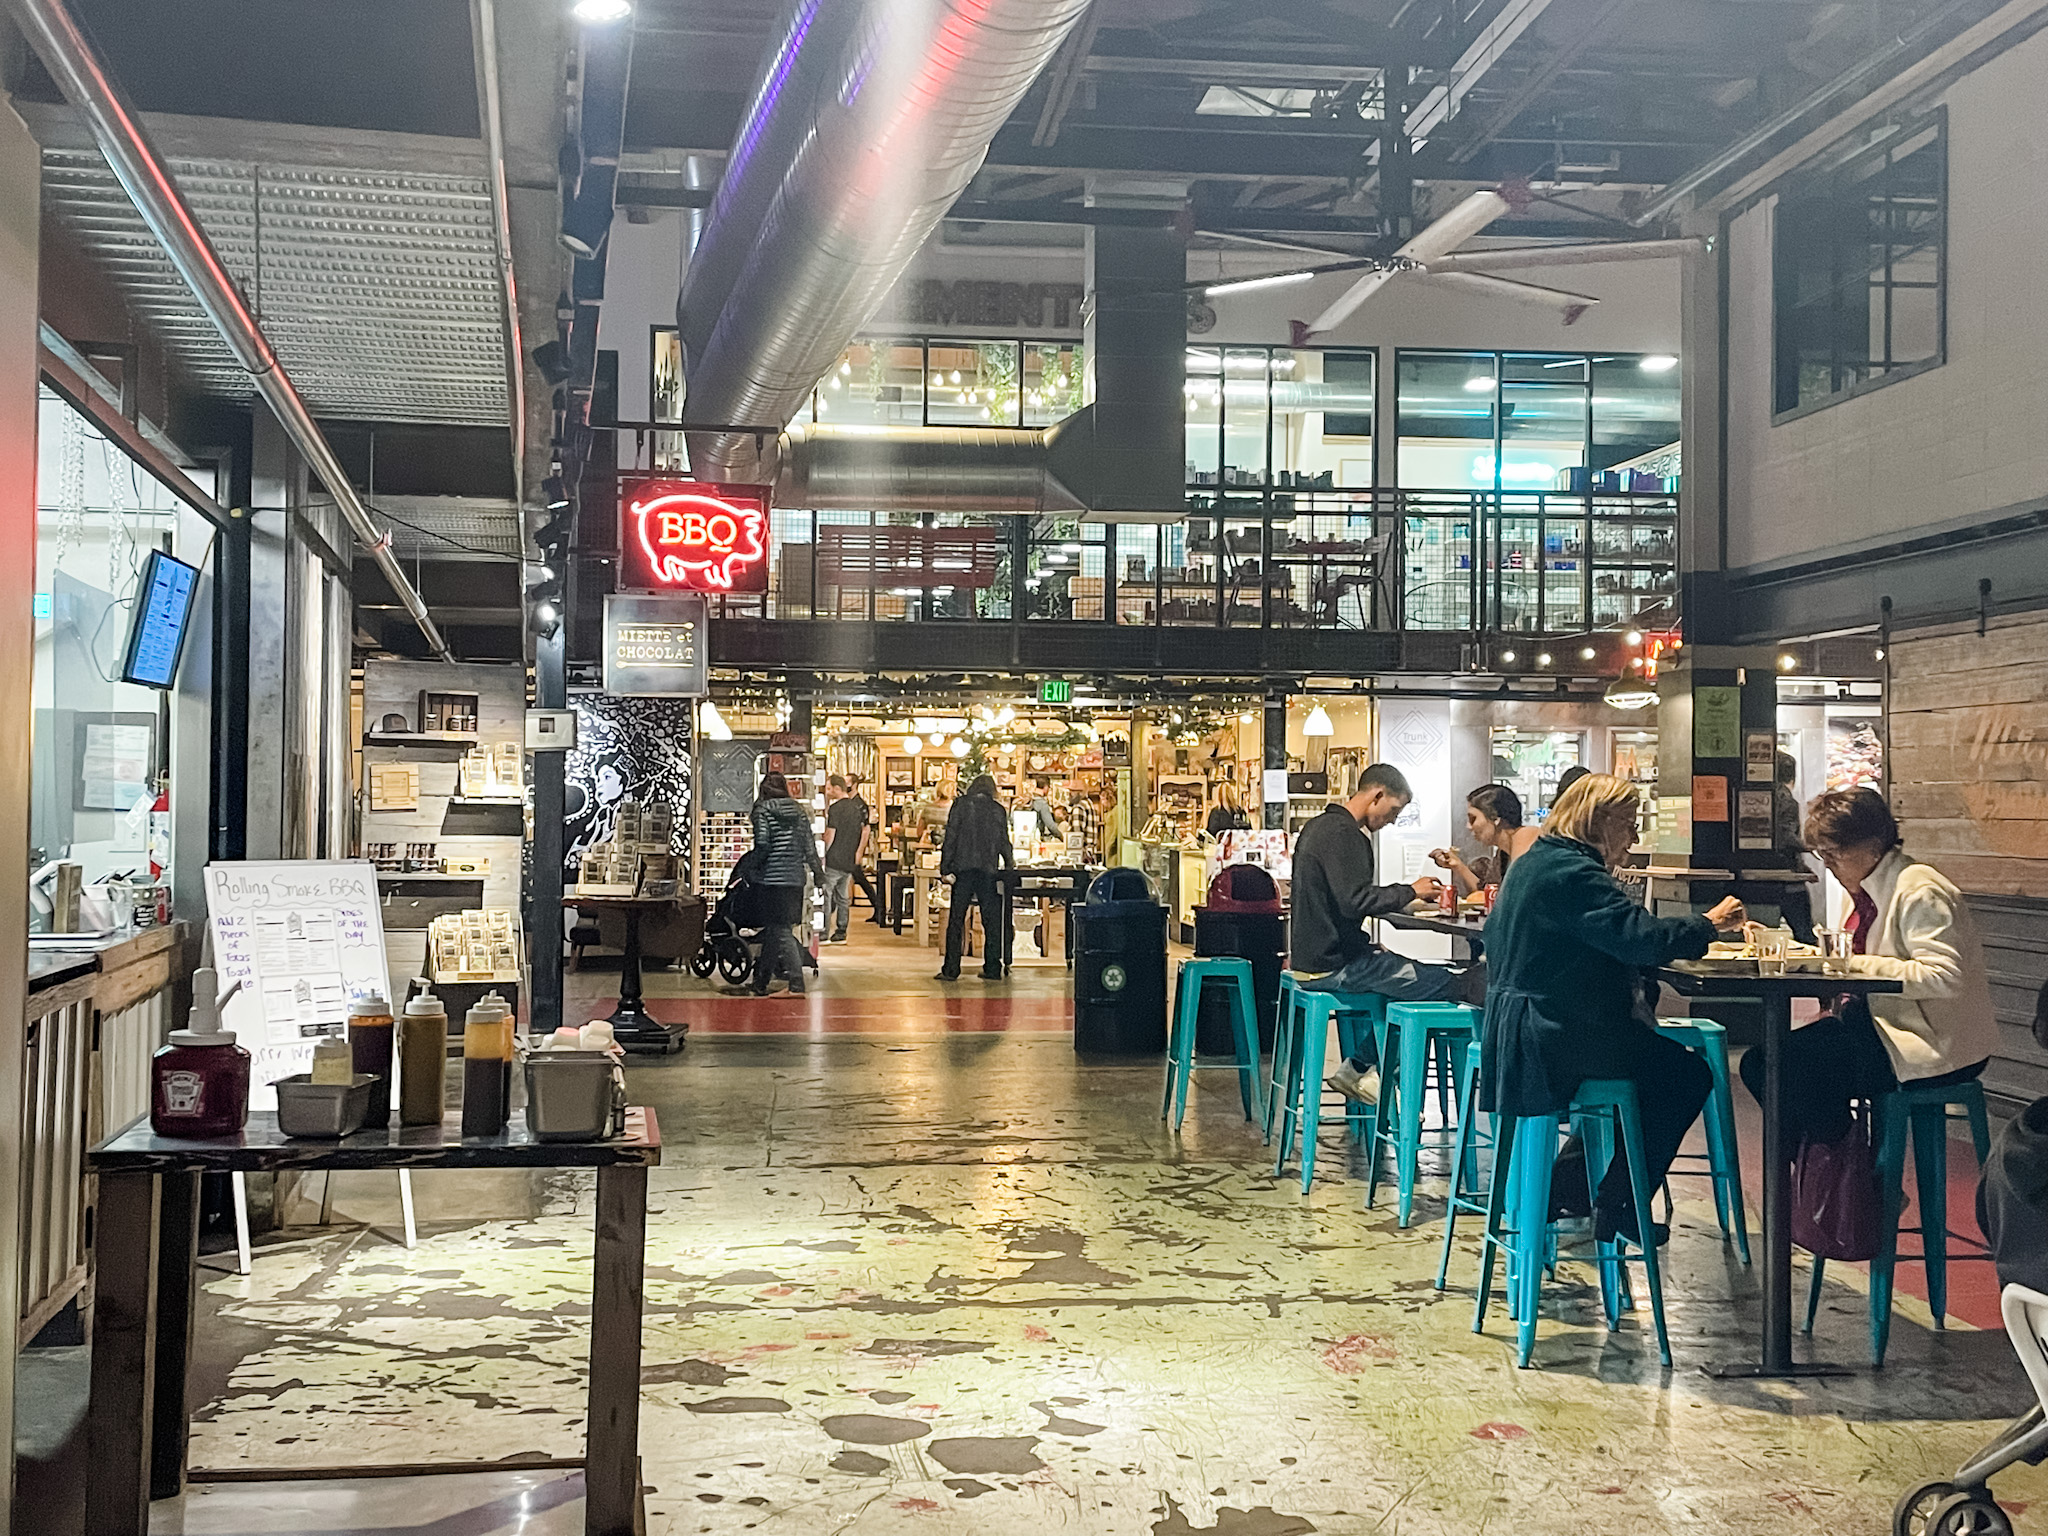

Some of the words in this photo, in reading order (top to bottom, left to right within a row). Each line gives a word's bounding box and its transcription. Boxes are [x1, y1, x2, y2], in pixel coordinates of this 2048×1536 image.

[657, 512, 737, 552] BBQ
[617, 630, 672, 643] MIETTE
[676, 632, 693, 643] et
[616, 646, 695, 659] CHOCOLAT
[1044, 681, 1070, 701] EXIT
[1403, 732, 1428, 741] Trunk
[215, 871, 270, 907] Rolling
[272, 874, 326, 897] Smoke
[329, 877, 366, 895] BBQ
